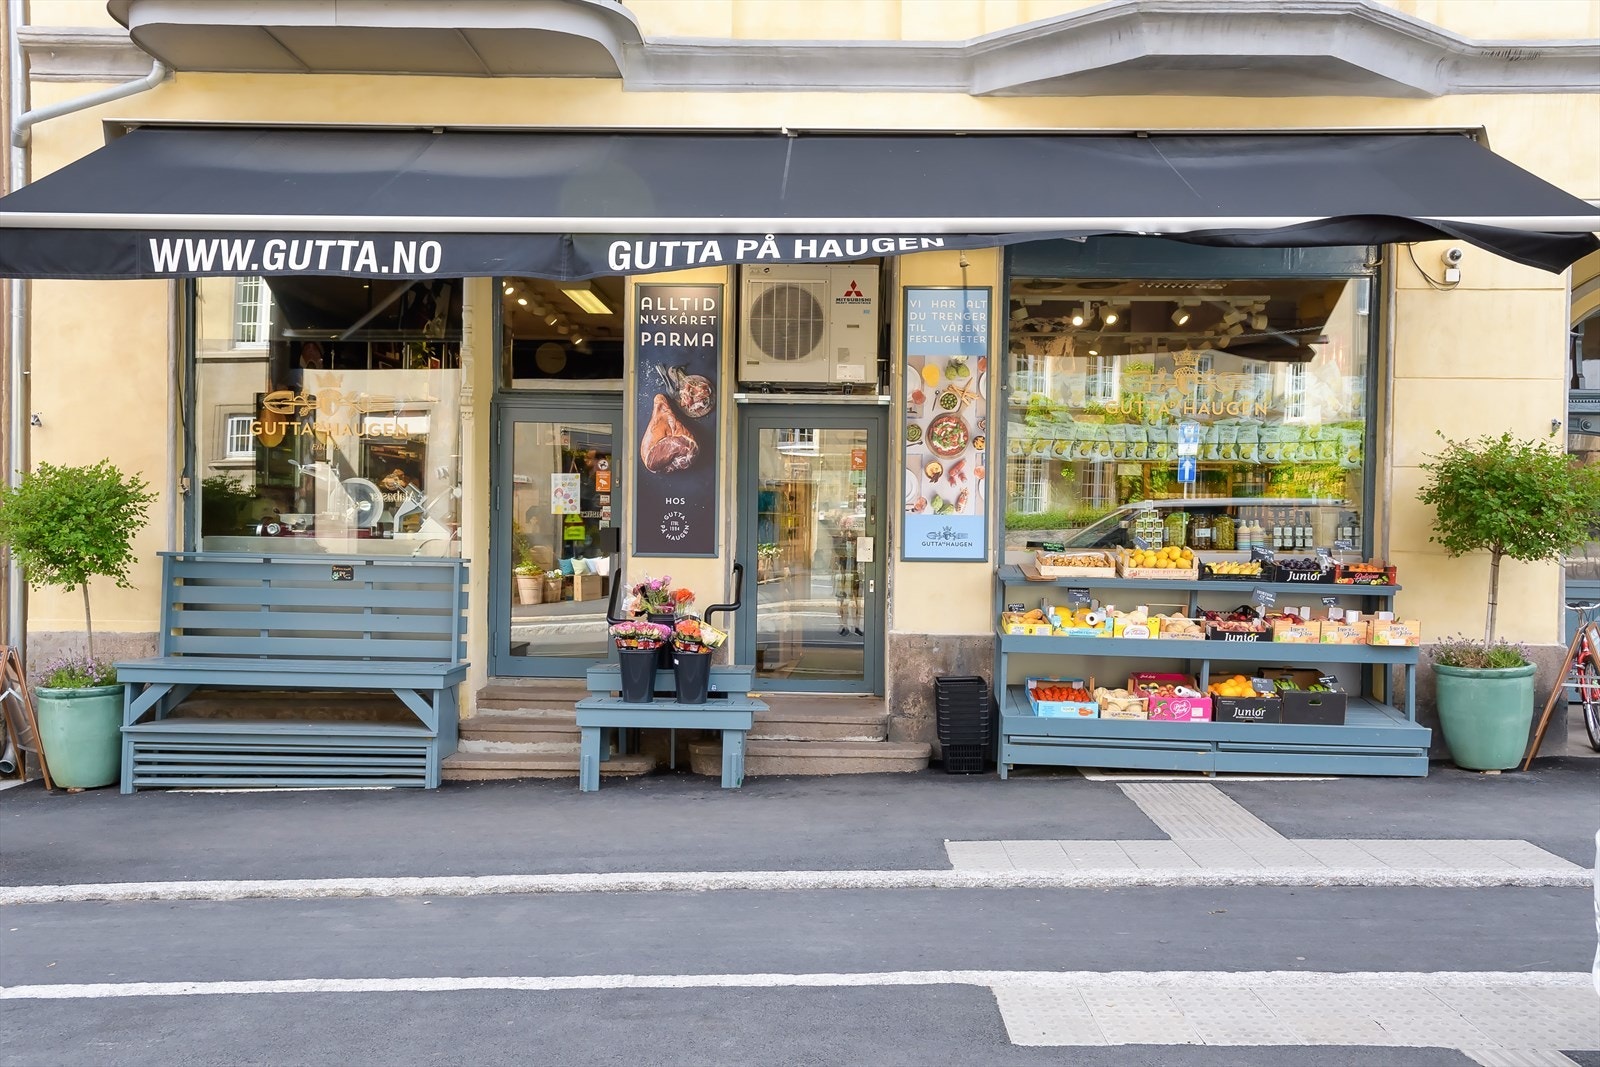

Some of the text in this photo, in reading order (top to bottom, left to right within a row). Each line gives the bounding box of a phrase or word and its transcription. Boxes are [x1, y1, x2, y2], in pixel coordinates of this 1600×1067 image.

[149, 238, 442, 274] WWW.GUTTA.NO
[608, 233, 945, 271] GUTTA PÅ HAUGEN
[641, 296, 715, 311] ALLTID
[909, 300, 987, 309] VI HAR ALT
[640, 312, 717, 326] NYSKÅRET
[910, 312, 986, 321] DU TRENGER
[909, 322, 986, 333] TIL VÅRENS
[641, 332, 714, 347] PARMA
[909, 335, 986, 344] FESTLIGHETER
[1105, 401, 1171, 415] GUTTA
[1183, 401, 1268, 416] HAUGEN
[250, 421, 314, 436] GUTTA
[327, 422, 409, 437] HAUGEN
[665, 497, 686, 505] HOS
[663, 511, 686, 520] GUTTA
[660, 524, 690, 541] PÅ HAUGEN
[1287, 571, 1322, 582] Junior
[1224, 632, 1260, 642] Junior
[1176, 706, 1188, 714] Lady
[1232, 707, 1266, 718] Junior
